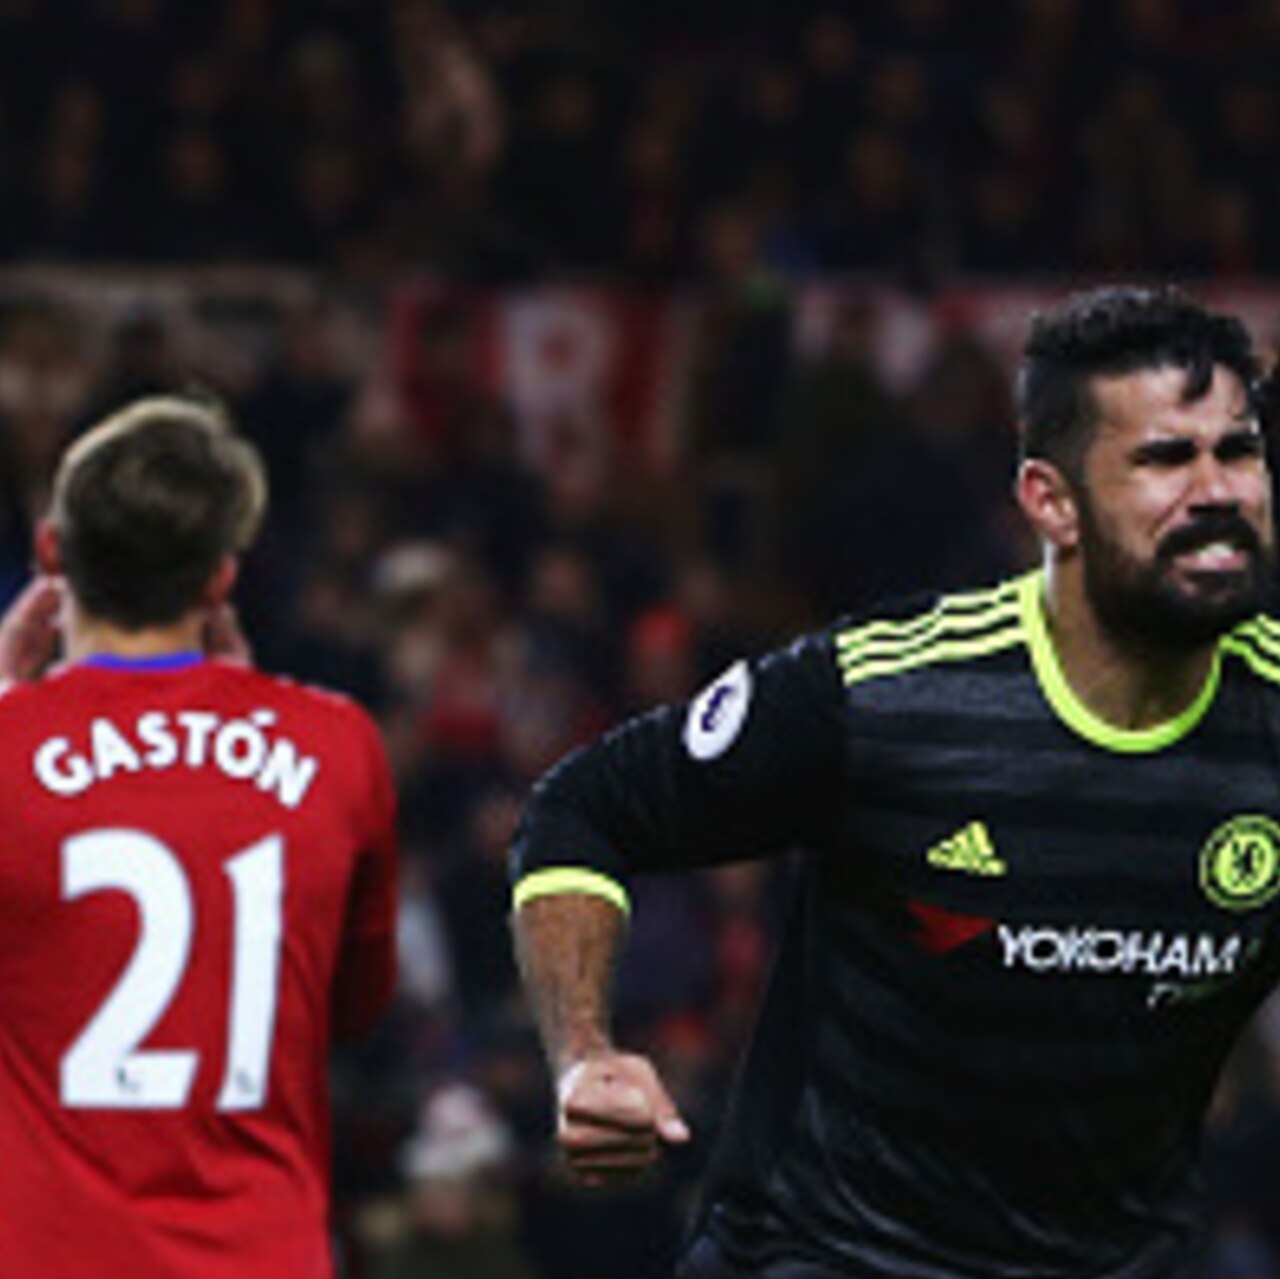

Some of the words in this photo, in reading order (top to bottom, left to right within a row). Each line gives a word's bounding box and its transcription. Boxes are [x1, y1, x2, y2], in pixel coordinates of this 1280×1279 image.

[34, 709, 318, 809] GASTÓN
[61, 828, 285, 1113] 21
[998, 924, 1260, 974] YOKOHAM
